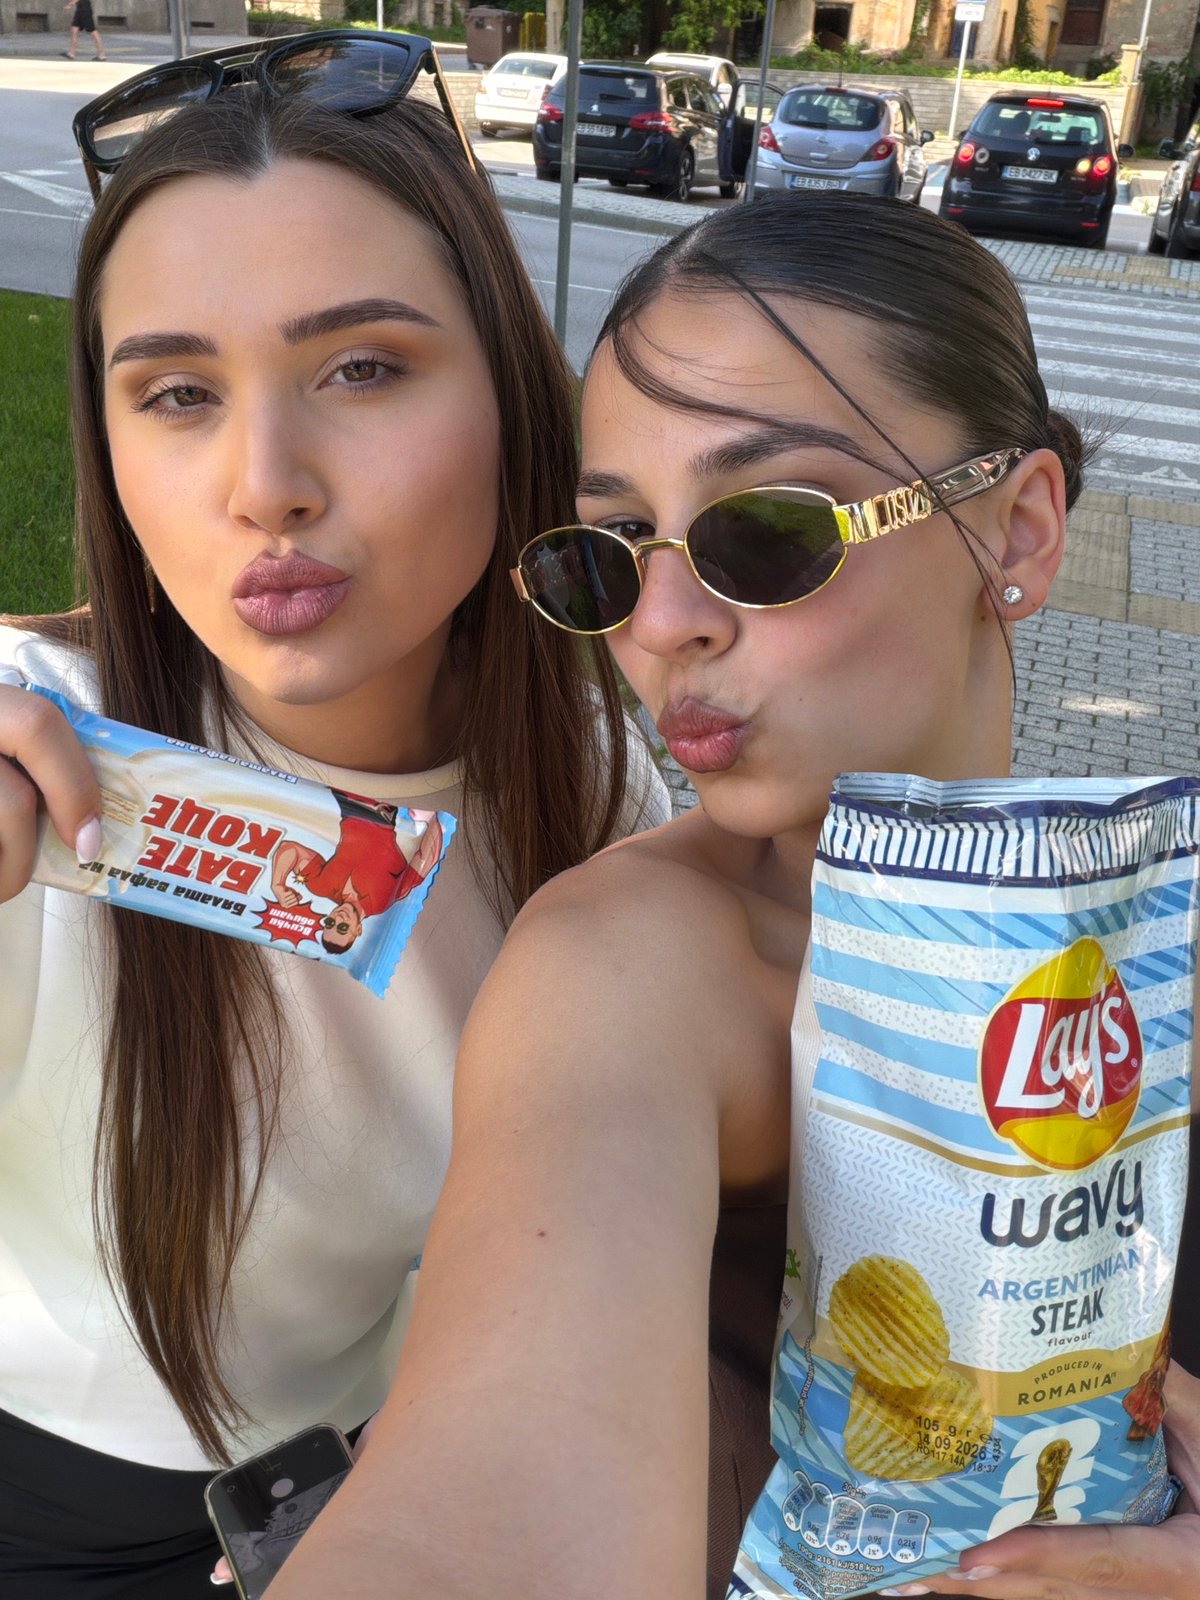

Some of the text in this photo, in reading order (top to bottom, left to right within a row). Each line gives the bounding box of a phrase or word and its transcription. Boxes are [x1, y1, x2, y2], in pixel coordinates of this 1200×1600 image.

[1008, 166, 1021, 178] EB
[1022, 167, 1042, 179] 0427
[140, 794, 283, 859] КОЦЕ
[137, 835, 263, 895] БАТЕ
[108, 867, 170, 892] вафла
[173, 885, 247, 916] Бялата
[269, 908, 316, 926] обичат
[269, 918, 313, 936] Всички
[995, 982, 1130, 1119] Lay's
[980, 1159, 1145, 1248] wavy
[977, 1248, 1145, 1301] ARGENTINIAN
[1030, 1287, 1104, 1337] STEAK
[1047, 1331, 1093, 1348] flavour
[1033, 1360, 1103, 1385] PRODUCED IN
[916, 1415, 940, 1432] 105
[916, 1430, 987, 1460] 14 09 2026
[972, 1461, 999, 1473] 18:37
[817, 1556, 836, 1567] 2161
[866, 1563, 884, 1574] kcal
